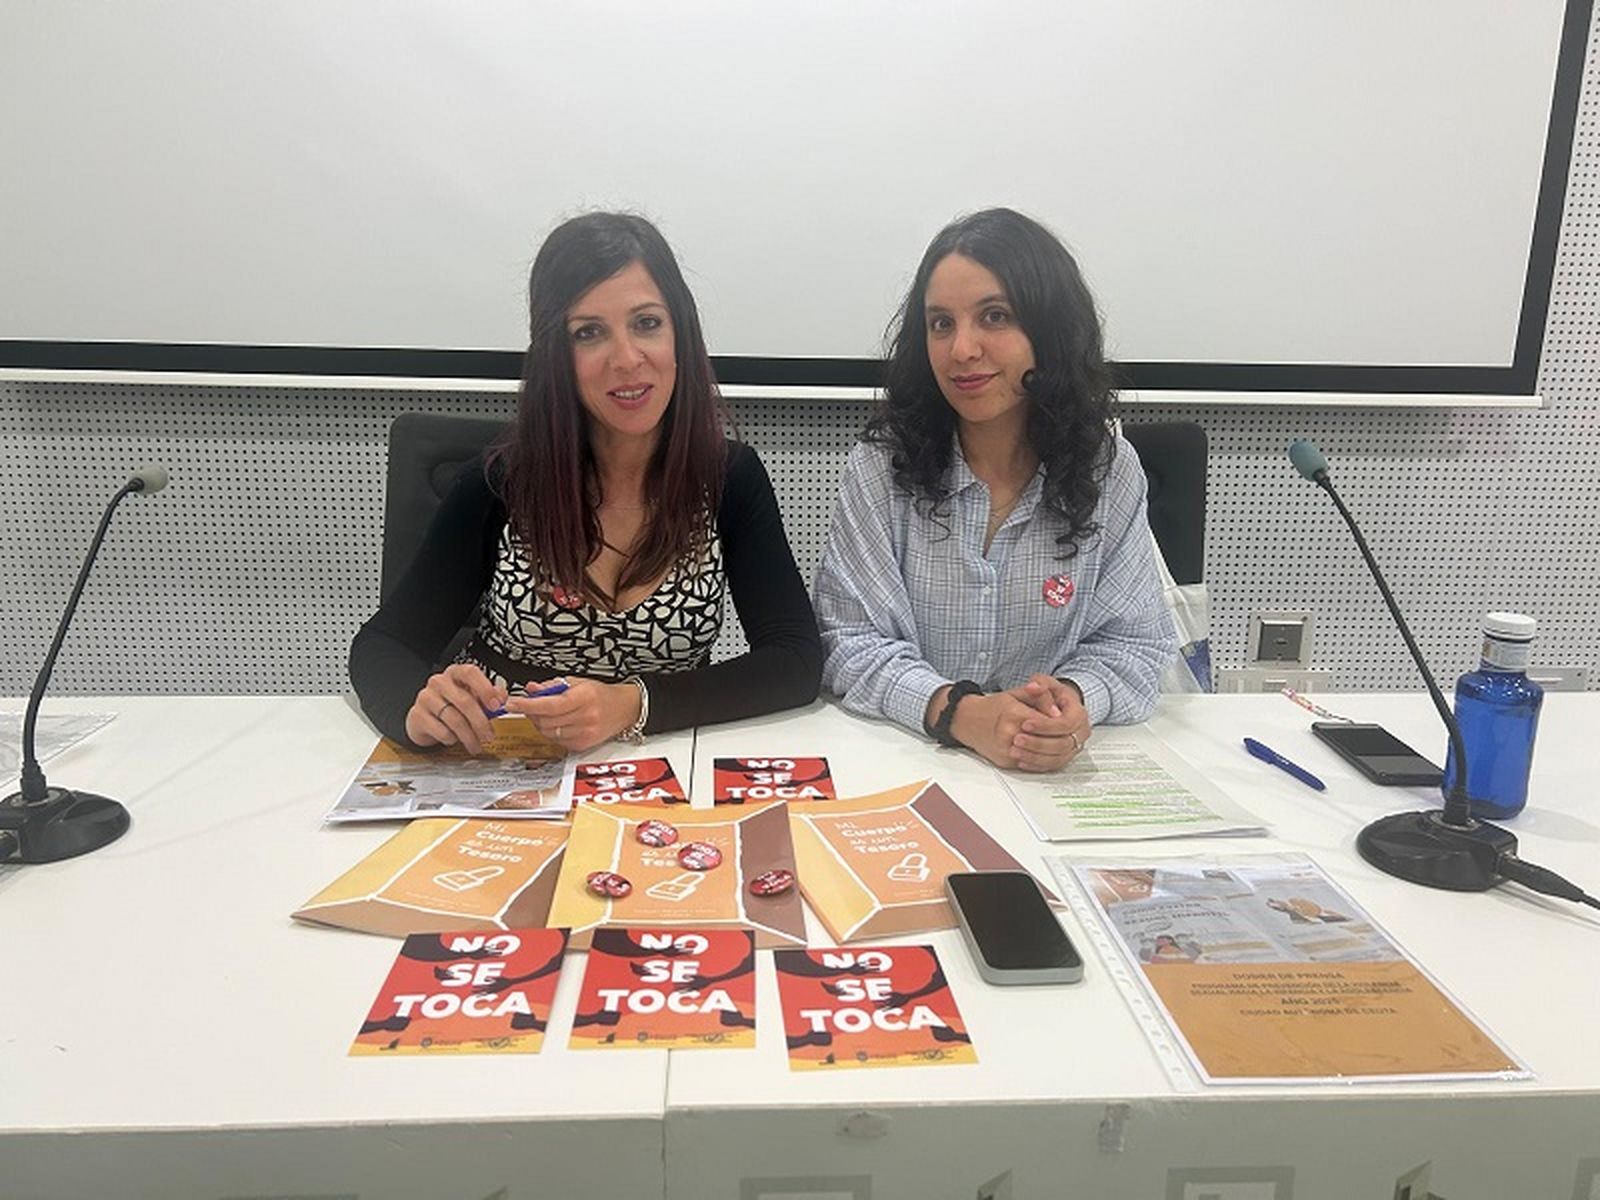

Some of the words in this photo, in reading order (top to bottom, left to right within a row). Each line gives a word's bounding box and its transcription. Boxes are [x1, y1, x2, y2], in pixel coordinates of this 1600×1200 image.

[586, 764, 638, 775] NO
[747, 759, 796, 770] NO
[595, 776, 636, 790] SE
[751, 773, 793, 785] SE
[573, 787, 674, 805] TOCA
[726, 786, 824, 799] TOCA
[475, 830, 544, 846] Cuerpo
[841, 825, 907, 838] Cuerpo
[458, 845, 523, 863] Tesoro
[852, 841, 920, 854] Tesoro
[450, 935, 521, 956] NO
[639, 933, 709, 955] NO
[822, 951, 893, 973] NO
[440, 962, 507, 987] SE
[640, 960, 700, 984] SE
[835, 977, 894, 1002] SE
[393, 991, 533, 1019] TOCA
[597, 989, 738, 1014] TOCA
[800, 1005, 946, 1033] TOCA
